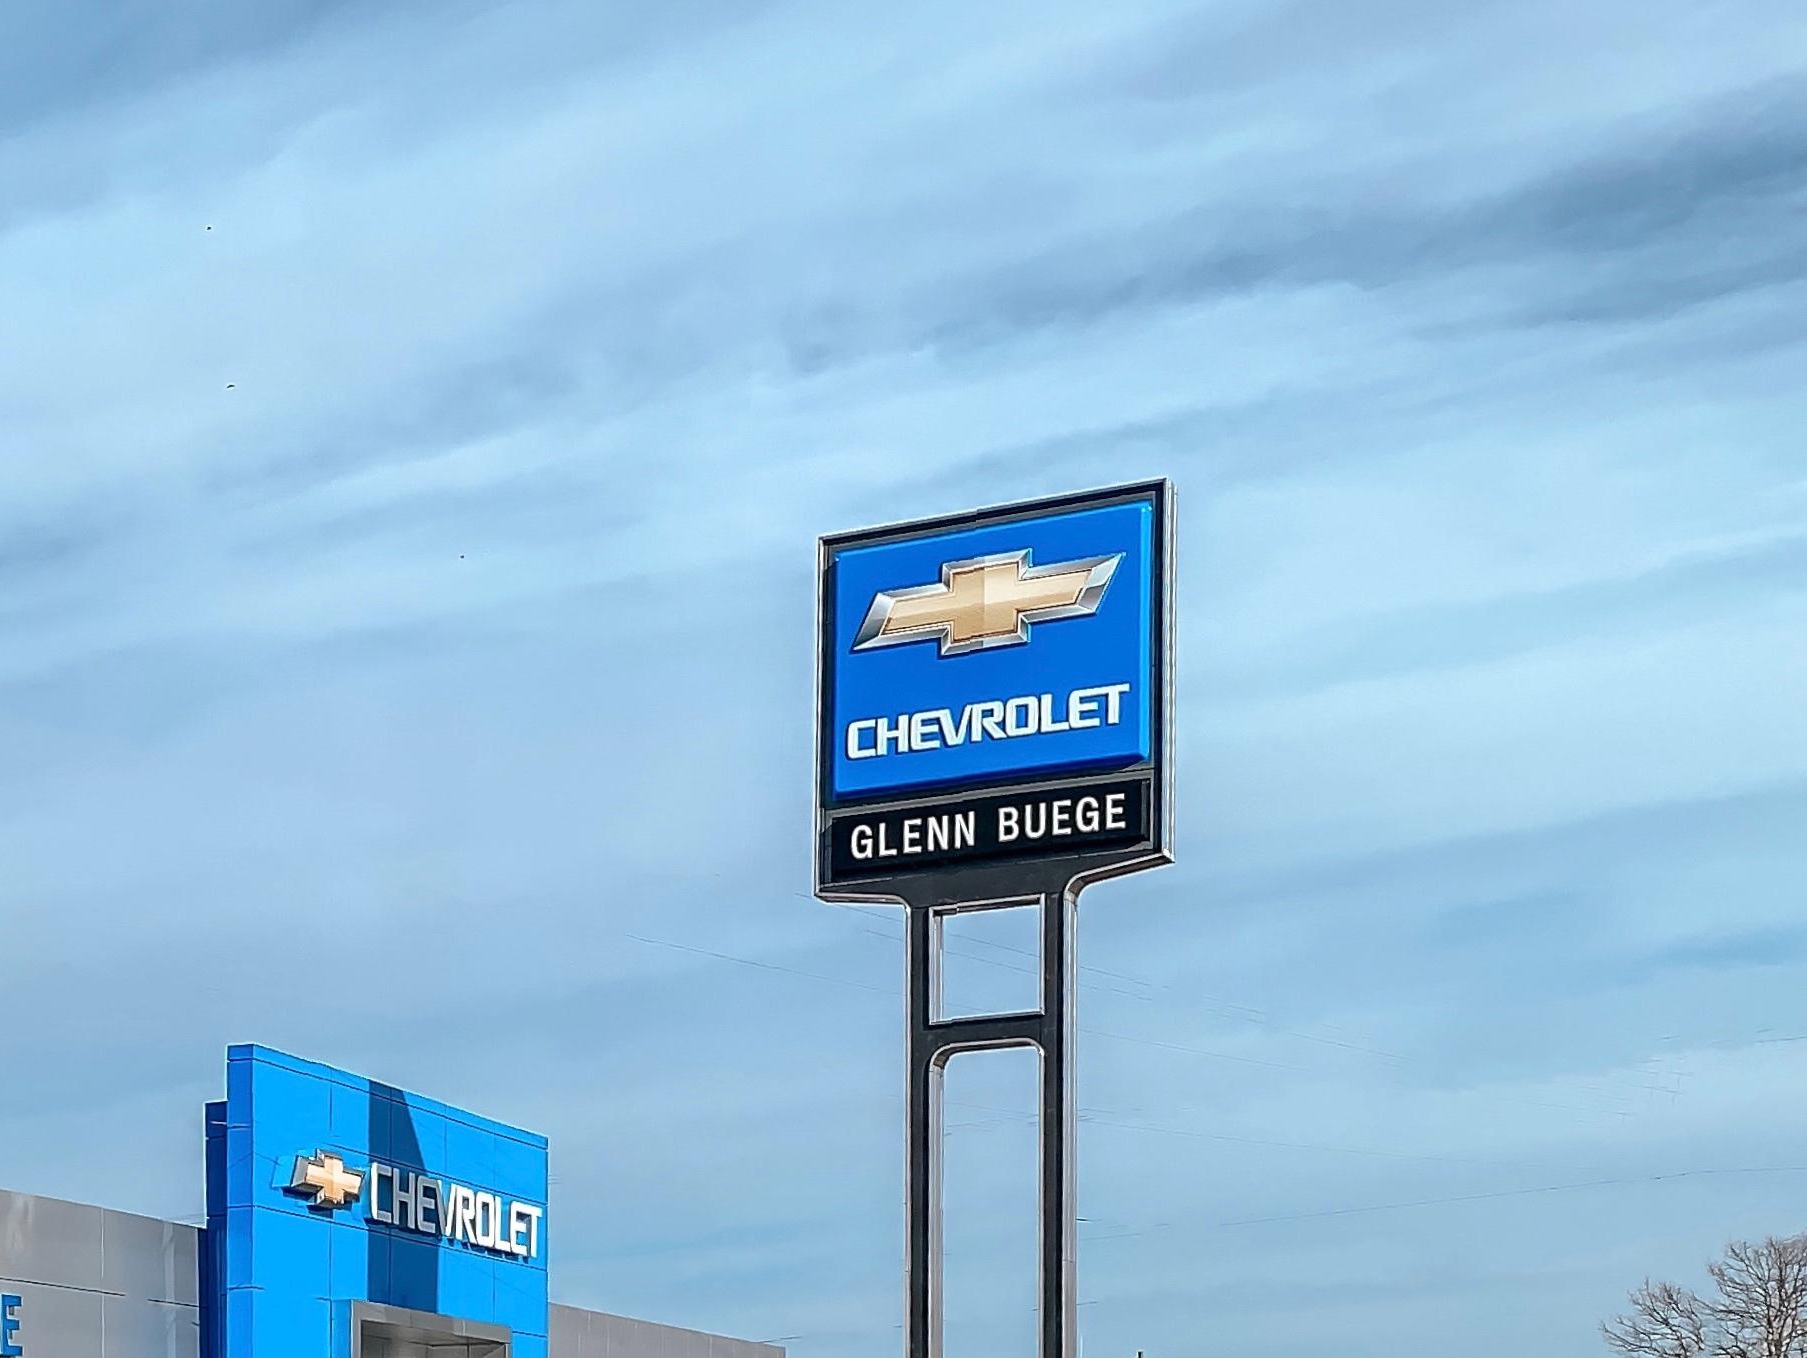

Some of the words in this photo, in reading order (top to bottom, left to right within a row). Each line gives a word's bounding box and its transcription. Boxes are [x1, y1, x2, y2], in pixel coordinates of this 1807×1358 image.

[846, 682, 1130, 760] CHEVROLET
[851, 810, 976, 860] GLENN
[998, 793, 1126, 843] BUEGE
[369, 1162, 542, 1259] CHEVROLET
